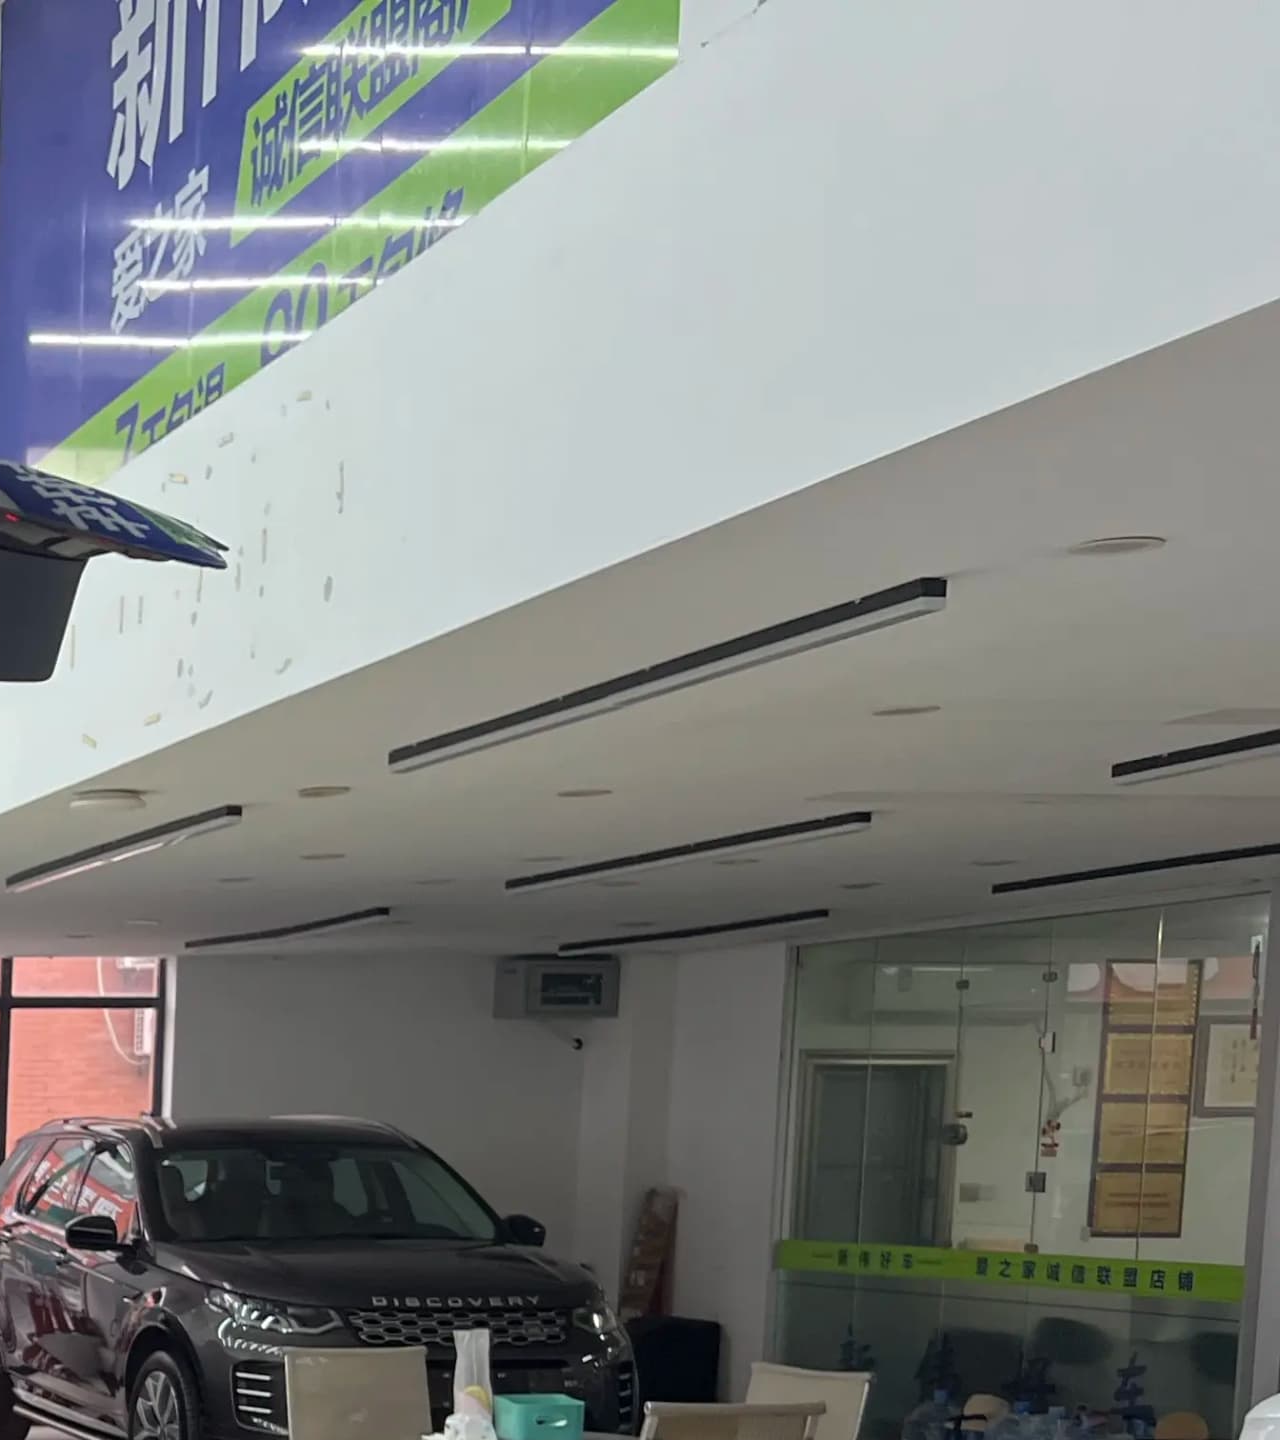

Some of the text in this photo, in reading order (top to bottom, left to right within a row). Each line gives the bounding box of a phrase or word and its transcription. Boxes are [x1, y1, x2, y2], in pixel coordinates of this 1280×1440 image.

[251, 0, 469, 207] 诚信联盟商
[371, 1295, 539, 1308] DISCOVERY
